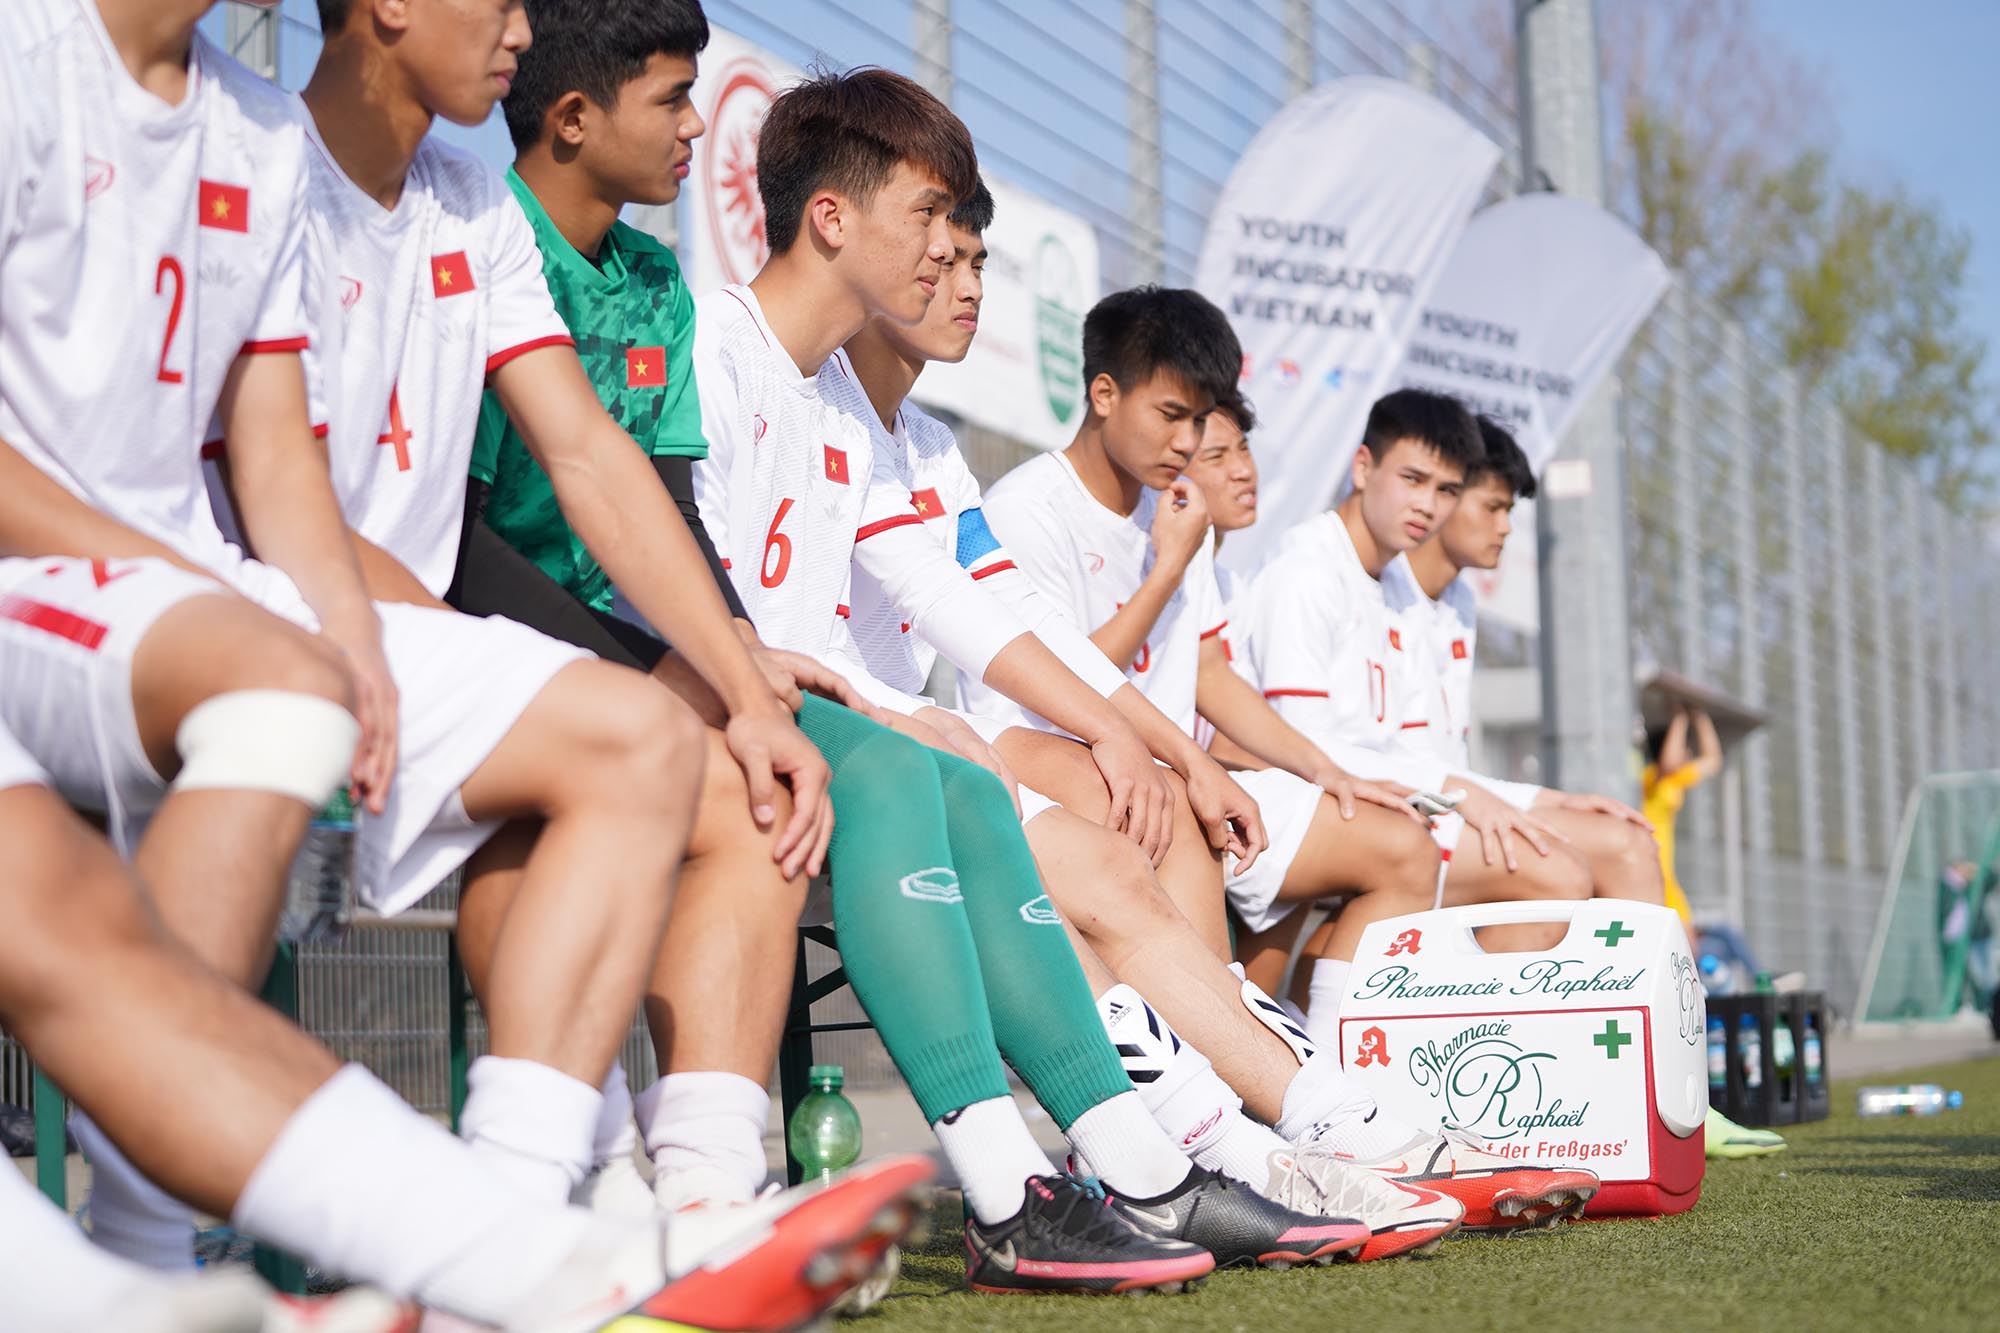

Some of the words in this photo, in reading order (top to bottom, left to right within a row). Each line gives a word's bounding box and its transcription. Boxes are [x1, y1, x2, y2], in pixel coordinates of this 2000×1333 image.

[1239, 216, 1346, 248] YOUTH
[1234, 256, 1414, 296] INCUBATOR
[155, 256, 184, 383] 2
[1232, 295, 1373, 330] VIETNAM
[1422, 311, 1518, 347] YOUTH
[1407, 343, 1575, 398] INCUBATOR
[761, 498, 795, 589] 6
[1353, 965, 1504, 1000] Pharmacie
[1510, 960, 1646, 1000] Raphaël
[1409, 1019, 1512, 1097] Pharmacie
[1500, 1141, 1530, 1159] der
